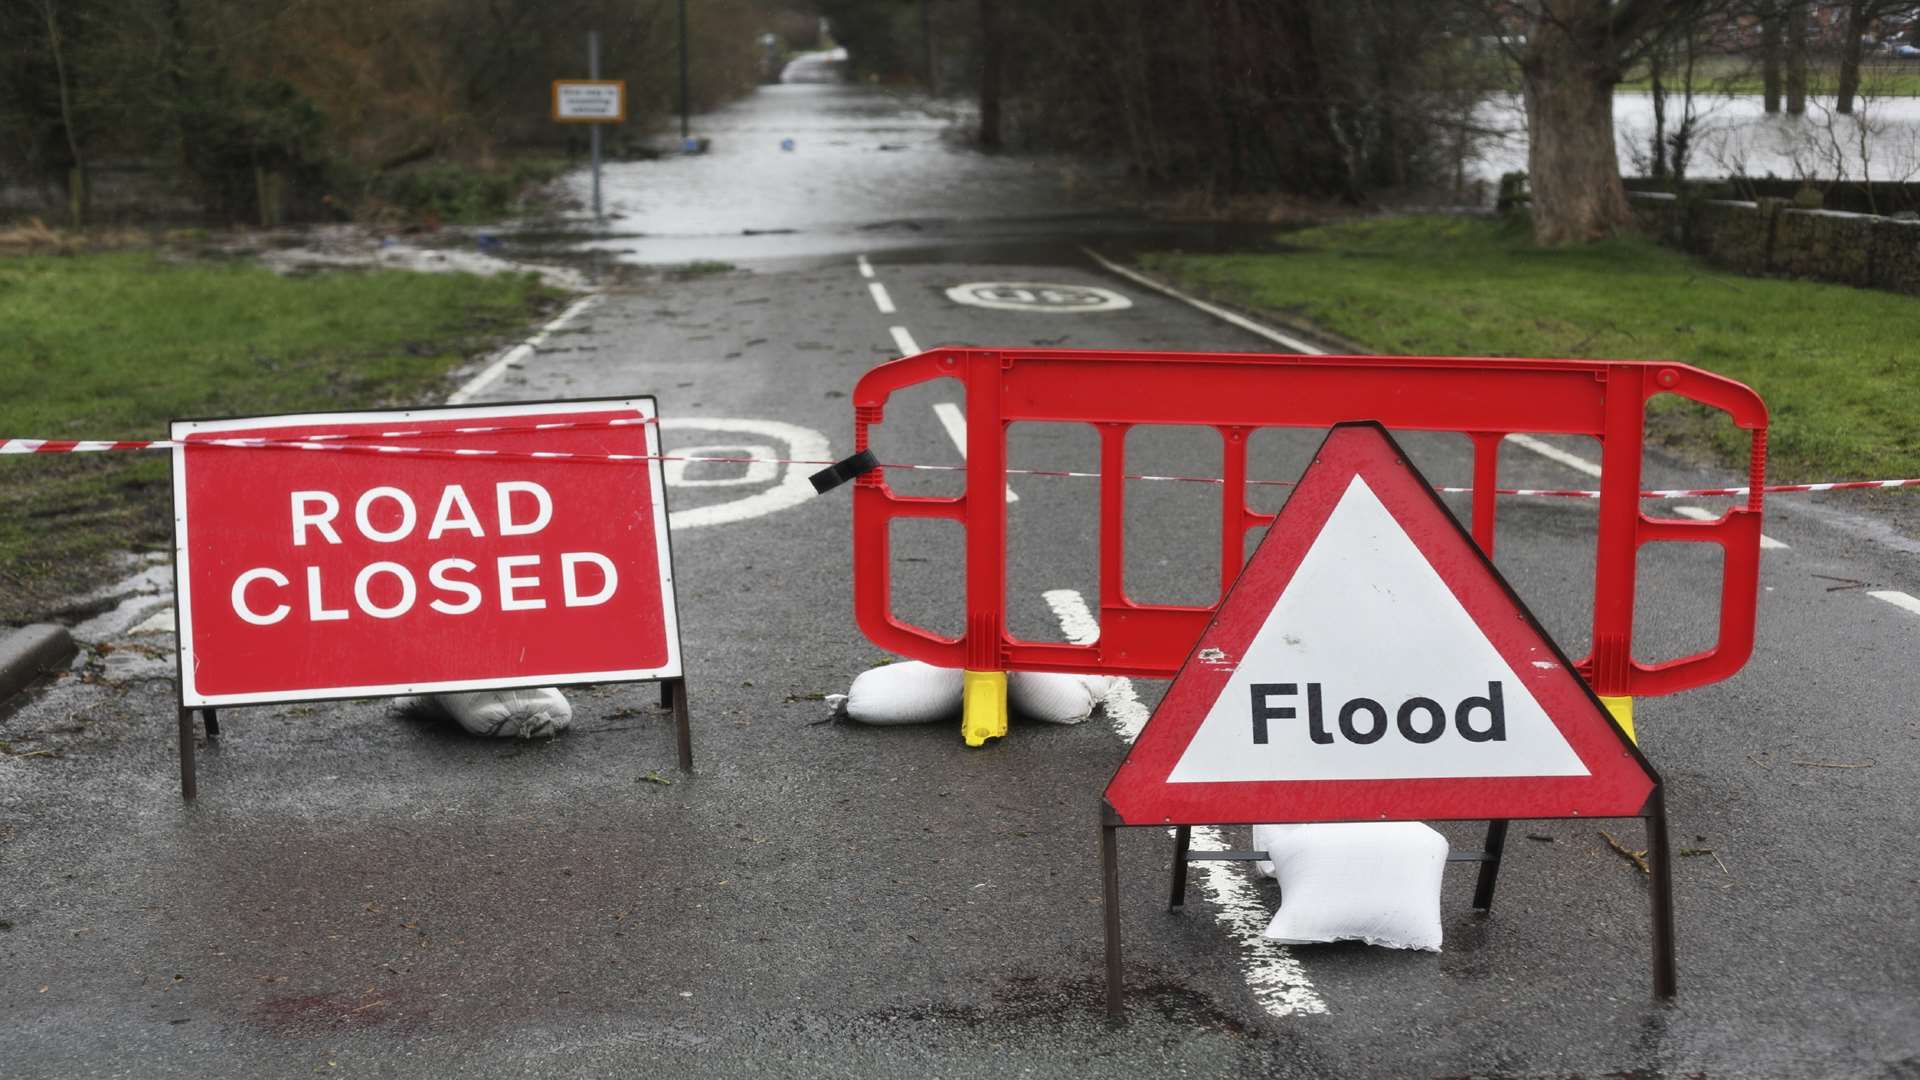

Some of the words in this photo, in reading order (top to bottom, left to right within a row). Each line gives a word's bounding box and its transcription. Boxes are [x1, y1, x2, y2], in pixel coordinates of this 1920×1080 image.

[290, 480, 553, 546] ROAD
[231, 551, 619, 626] CLOSED
[1250, 680, 1507, 745] Flood
